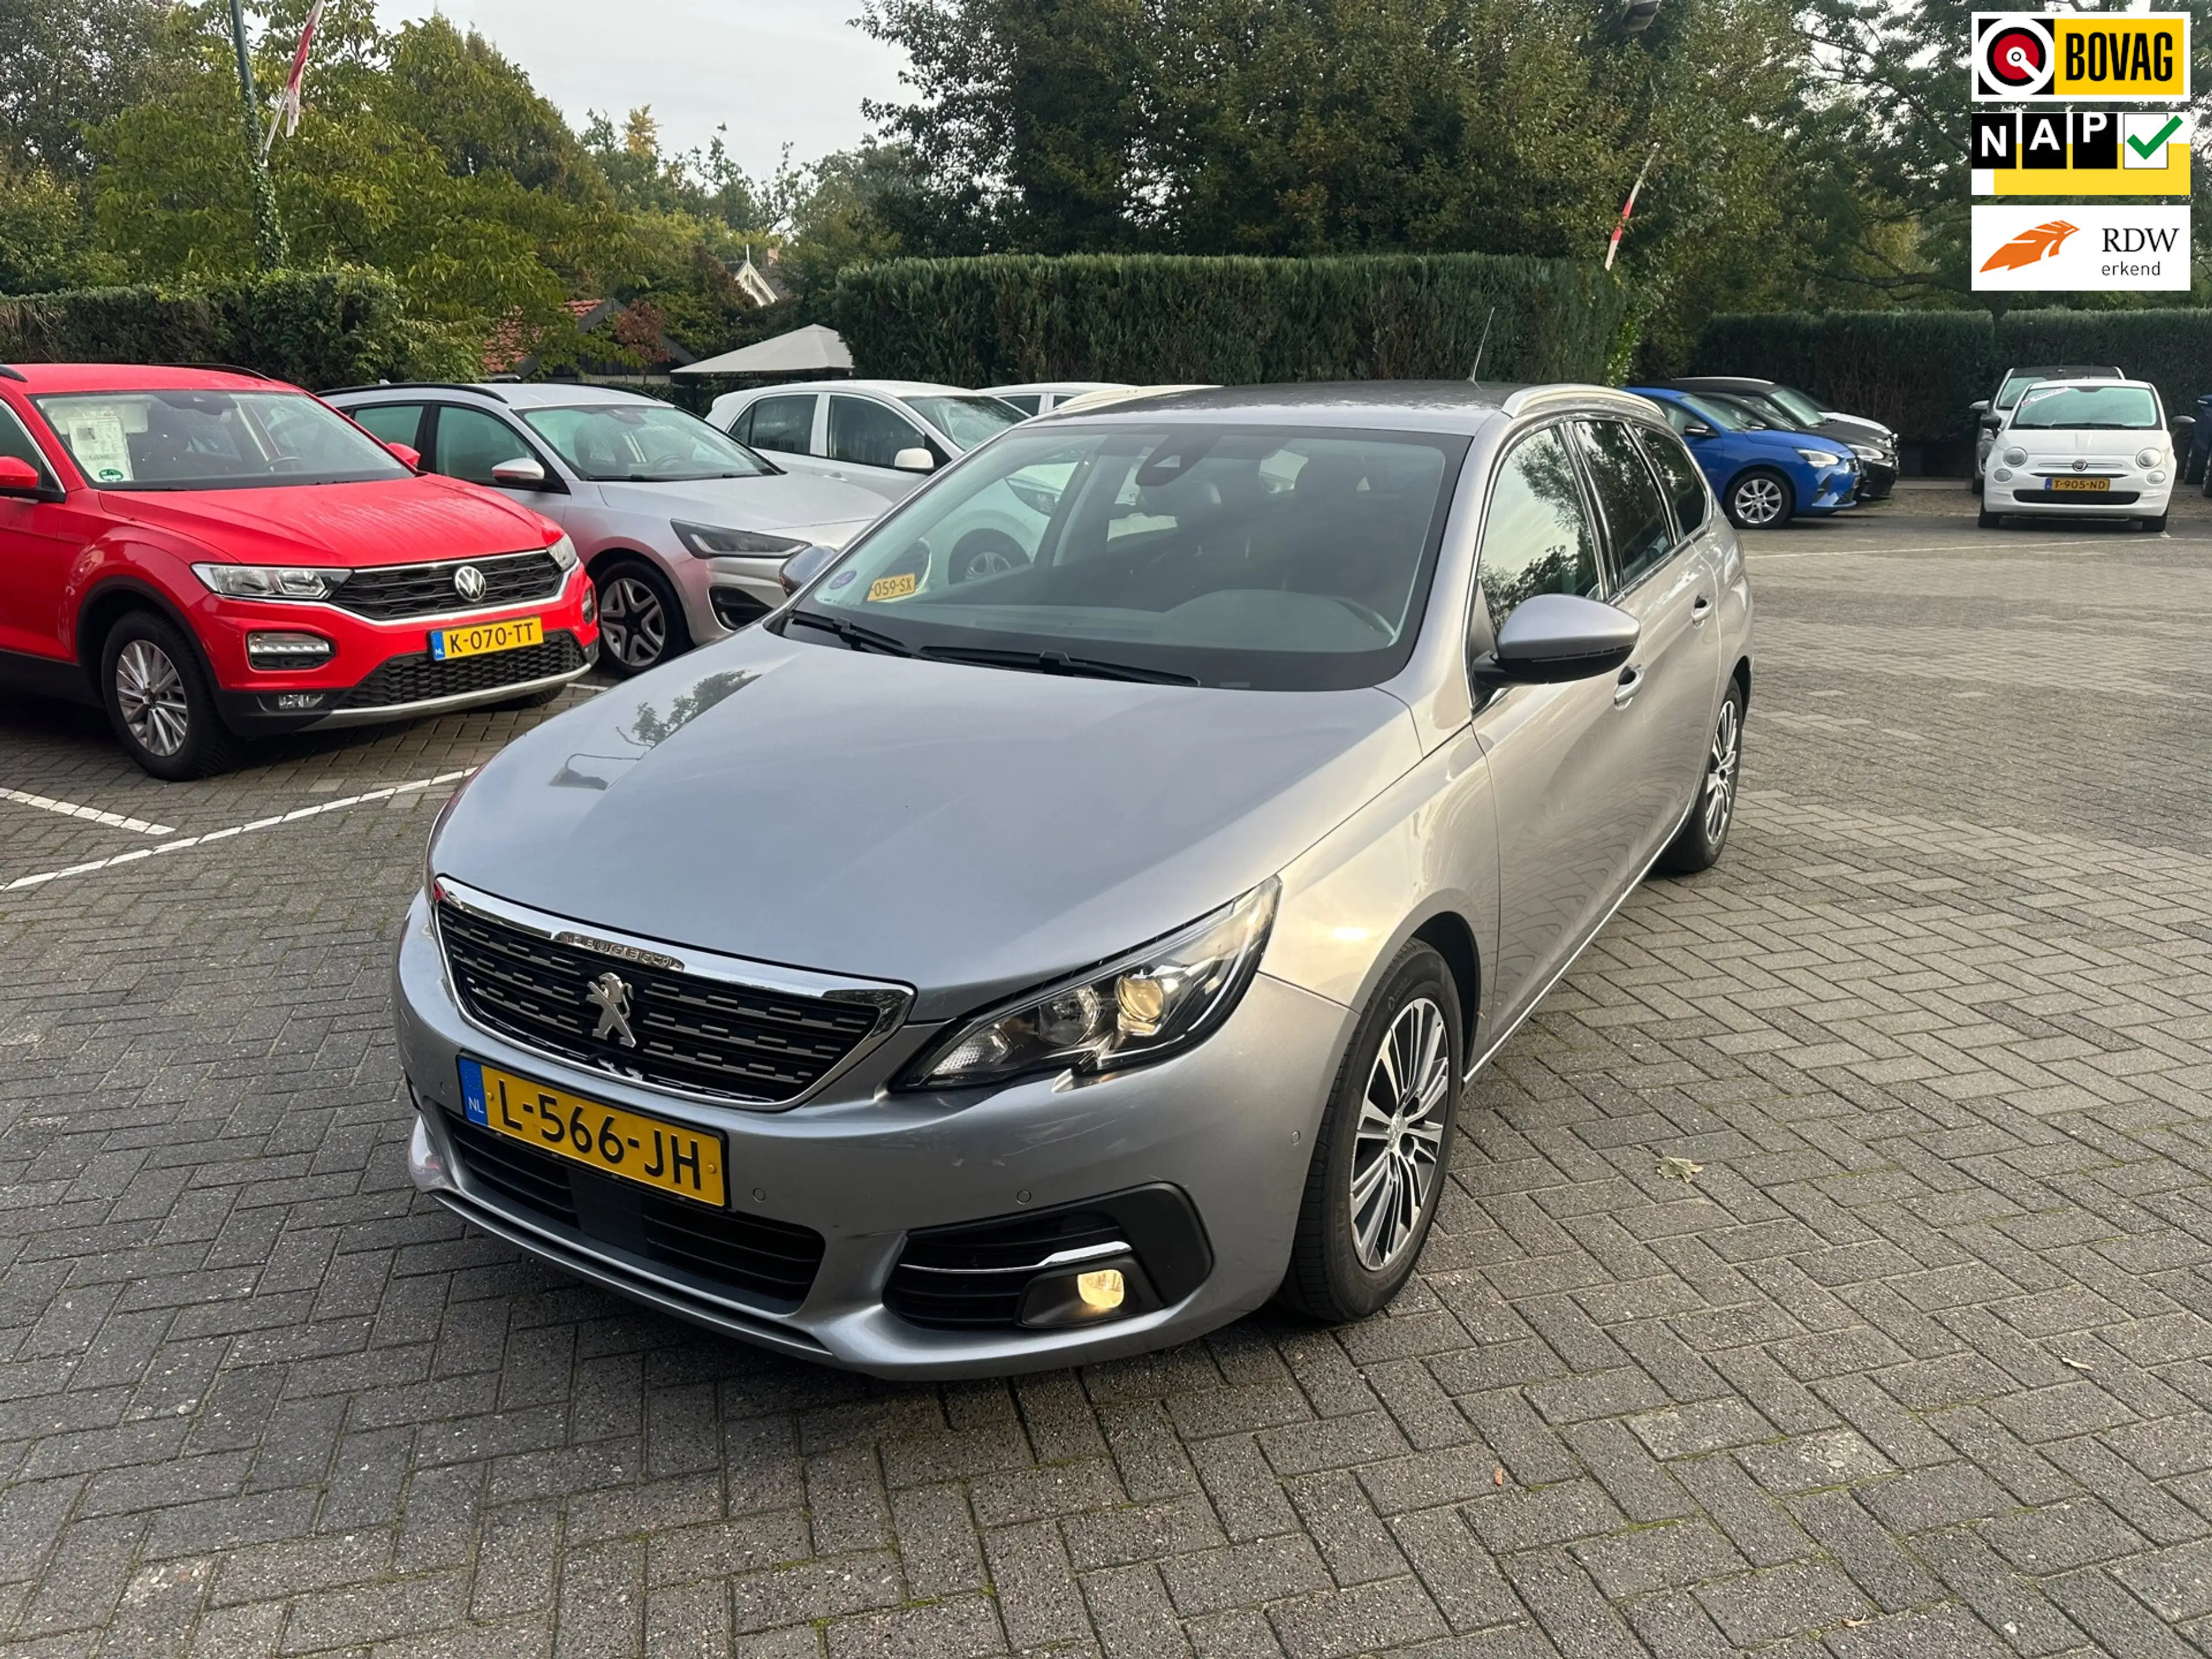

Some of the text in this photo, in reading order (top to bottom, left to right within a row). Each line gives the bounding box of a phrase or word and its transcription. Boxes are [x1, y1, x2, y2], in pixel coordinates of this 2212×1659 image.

[2054, 480, 2105, 489] T-905-ND
[449, 622, 533, 653] K-070-TT
[468, 1096, 484, 1114] NL
[498, 1078, 701, 1191] L-566-JH
